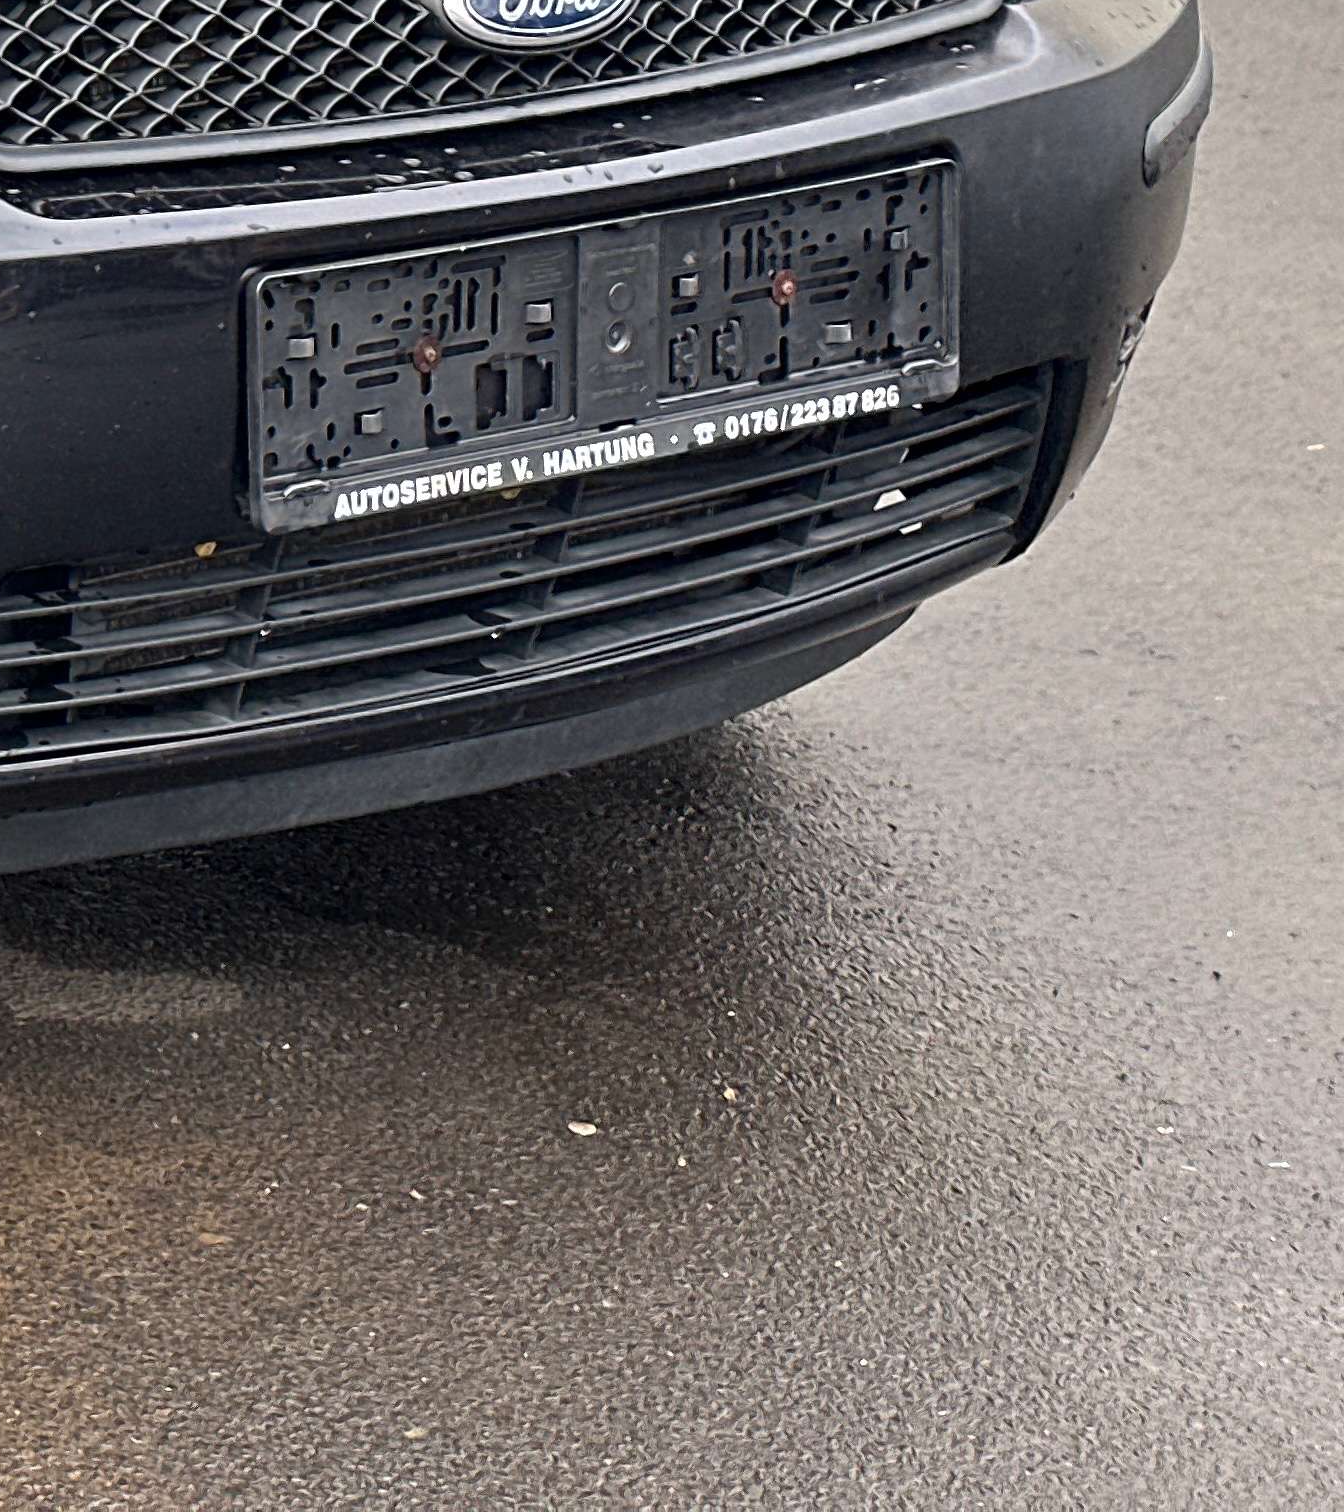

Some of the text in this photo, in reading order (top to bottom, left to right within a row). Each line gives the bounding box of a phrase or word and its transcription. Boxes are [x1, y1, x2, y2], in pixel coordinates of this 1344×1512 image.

[334, 461, 504, 521] AUTOSERVICE
[511, 456, 534, 482] V.
[543, 432, 655, 477] HARTUNG
